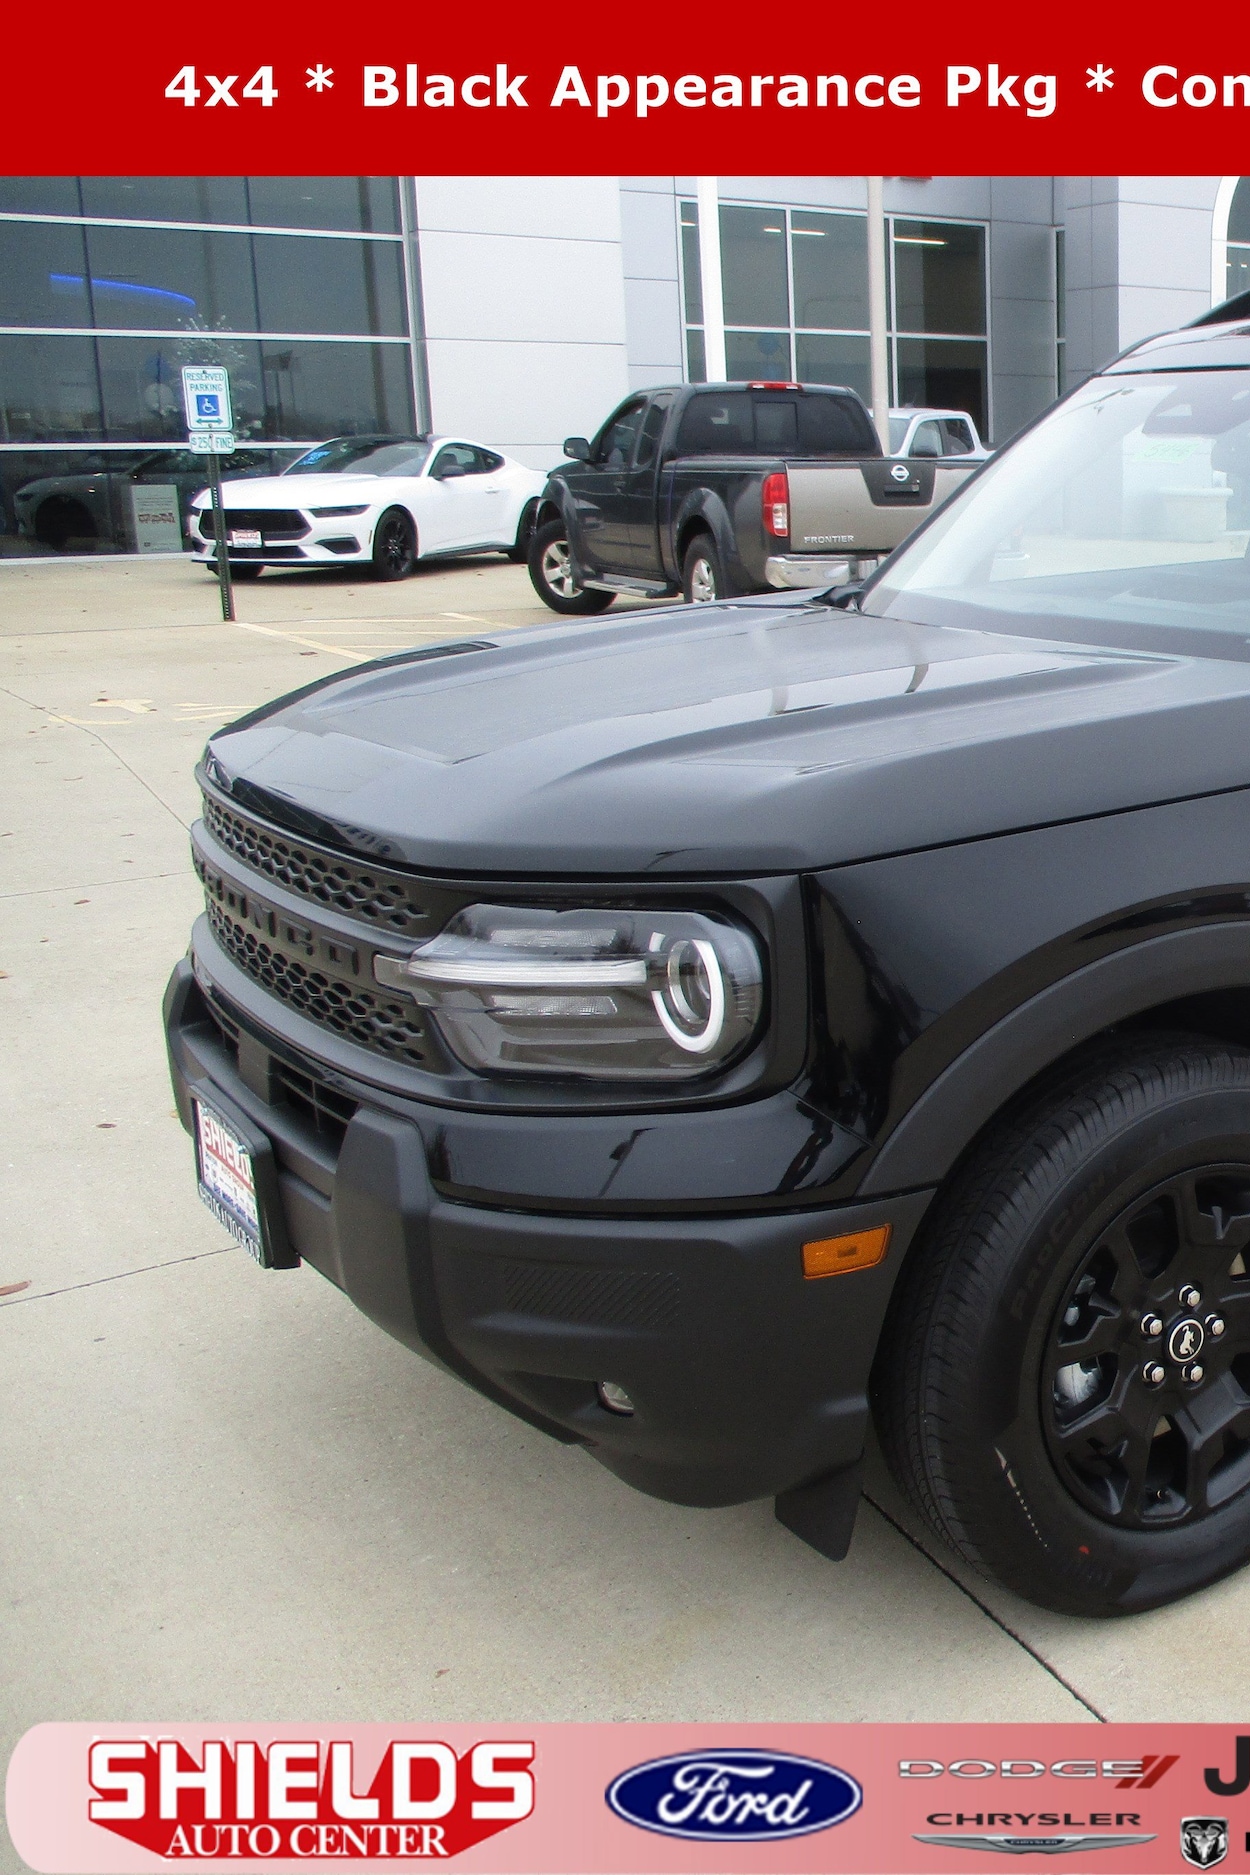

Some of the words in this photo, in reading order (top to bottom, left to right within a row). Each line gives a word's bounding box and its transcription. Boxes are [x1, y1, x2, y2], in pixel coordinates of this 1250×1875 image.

[187, 372, 225, 381] RESERVED
[190, 383, 222, 392] PARKING
[215, 436, 233, 449] FINE
[803, 534, 855, 544] FRONTIER
